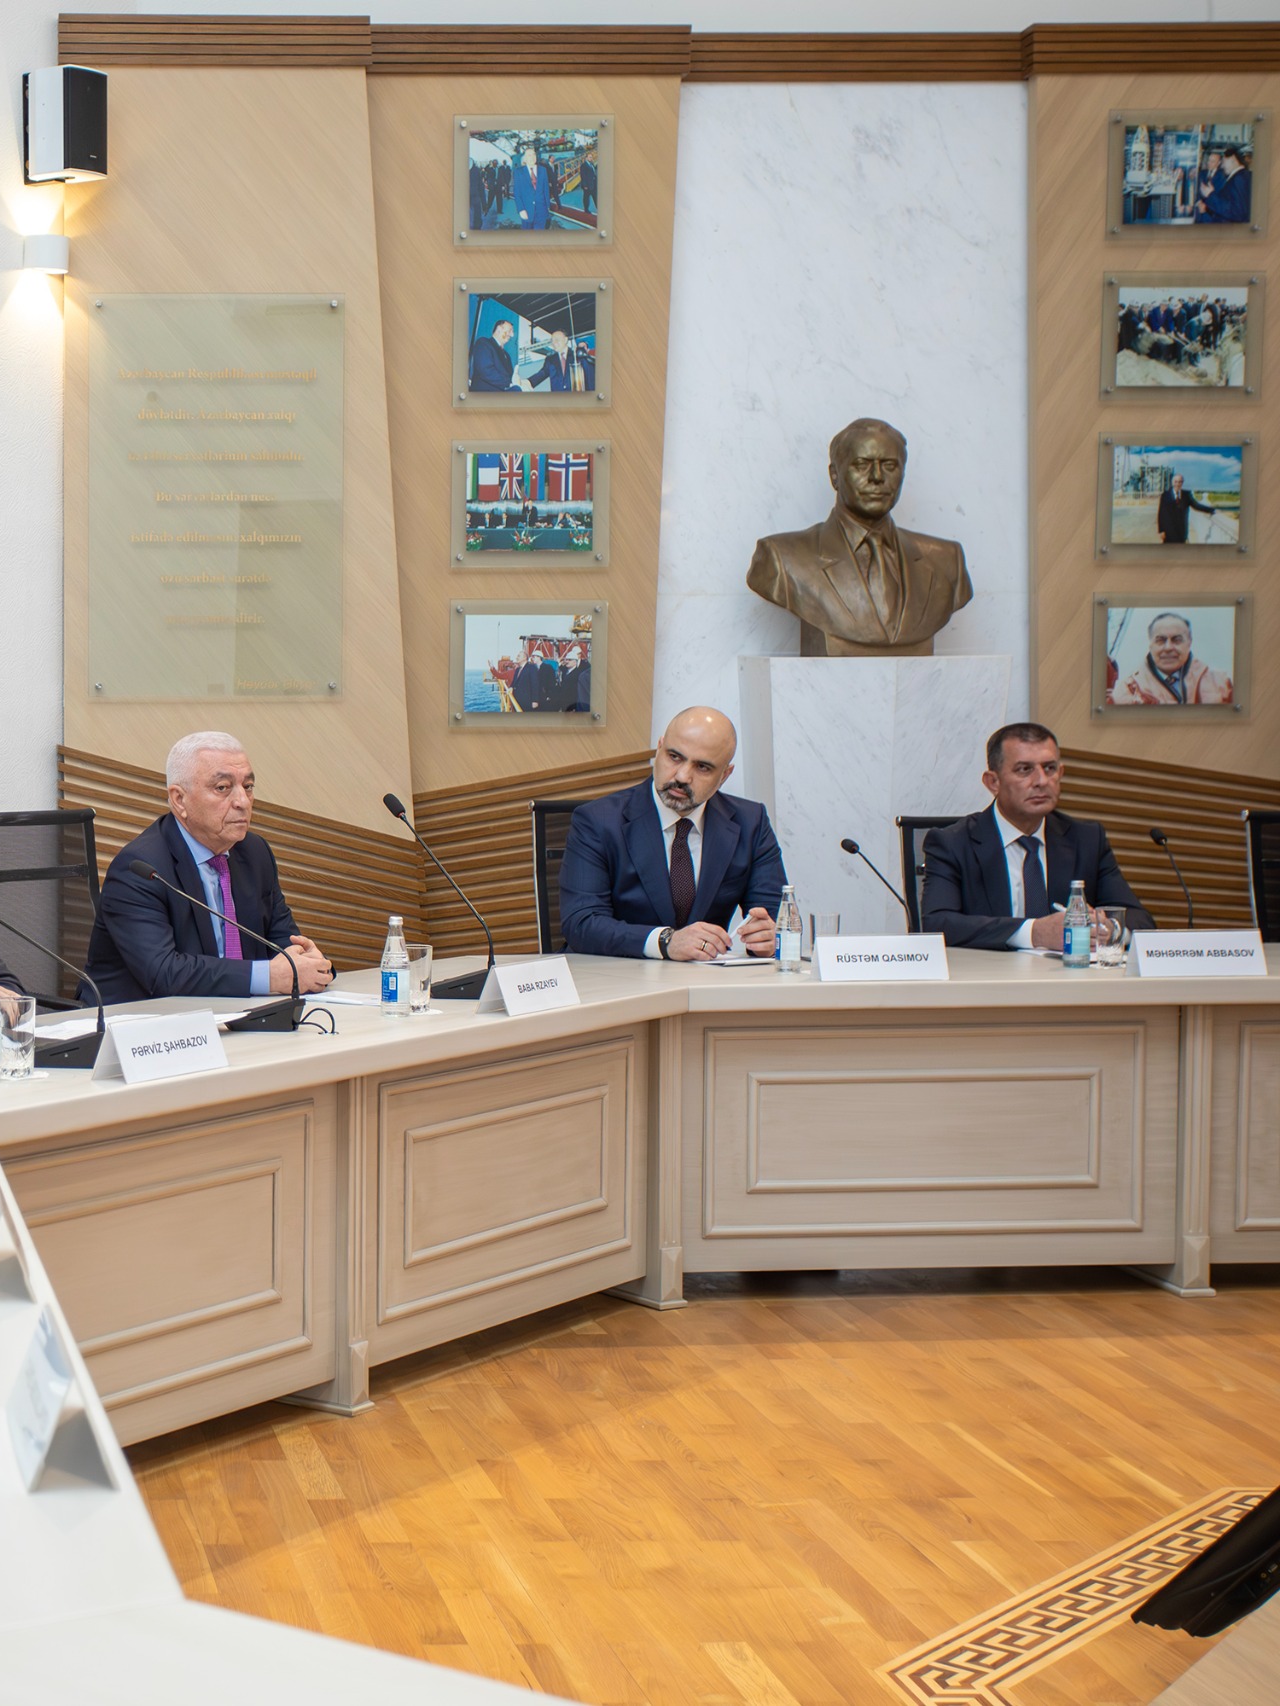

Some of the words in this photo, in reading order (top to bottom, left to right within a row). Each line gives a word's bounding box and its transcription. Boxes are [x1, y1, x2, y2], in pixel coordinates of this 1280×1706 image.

[836, 953, 880, 963] RÜSTƏM
[881, 953, 929, 963] QASIMOV
[1146, 949, 1204, 958] MƏHƏRRƏM
[1206, 949, 1255, 958] ABBASOV
[517, 983, 536, 994] BABA
[535, 978, 559, 991] RZAYEV
[131, 1042, 163, 1058] PƏRVİZ
[164, 1035, 208, 1054] ŞAHBAZOV
